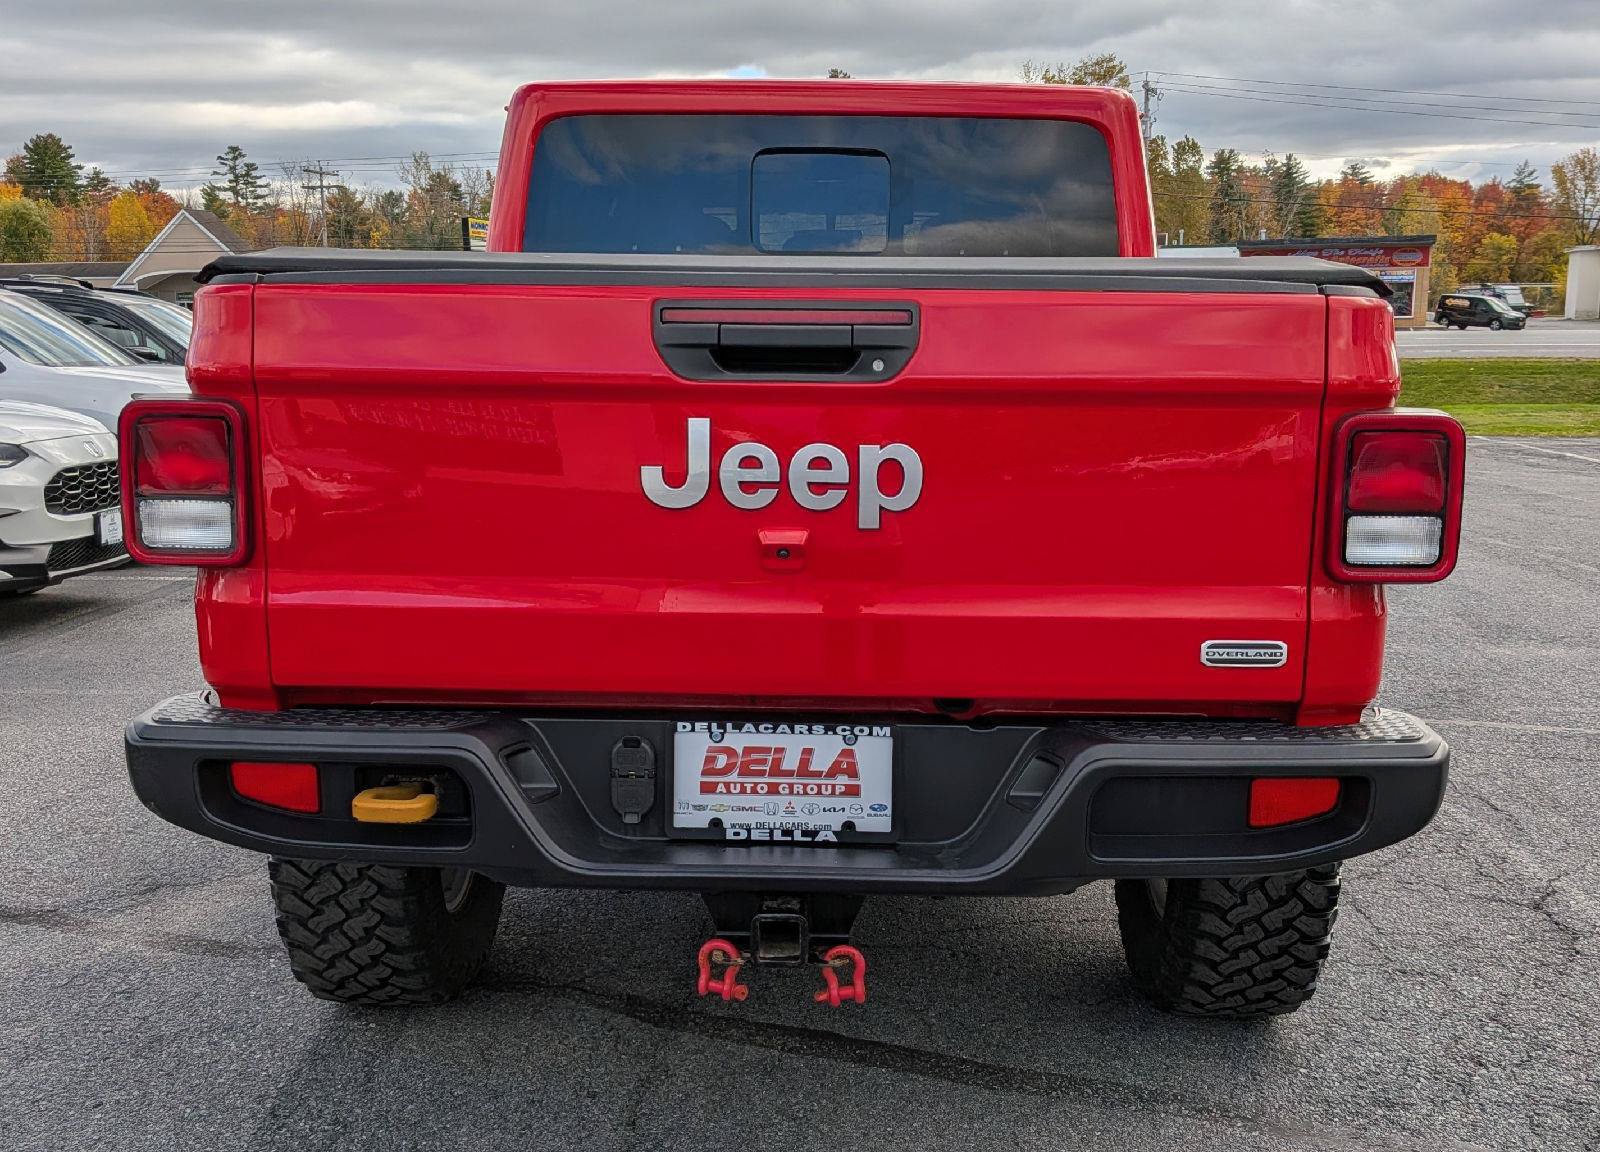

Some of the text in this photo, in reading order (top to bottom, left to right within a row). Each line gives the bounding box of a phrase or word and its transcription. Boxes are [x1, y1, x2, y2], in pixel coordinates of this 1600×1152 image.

[640, 417, 923, 529] Jeep
[676, 721, 891, 737] DELLACARS.COM
[700, 745, 861, 781] DELLA
[715, 783, 846, 796] AUTO GROUP
[730, 821, 832, 831] www.DELLACARS.com
[726, 829, 838, 842] DELLA
